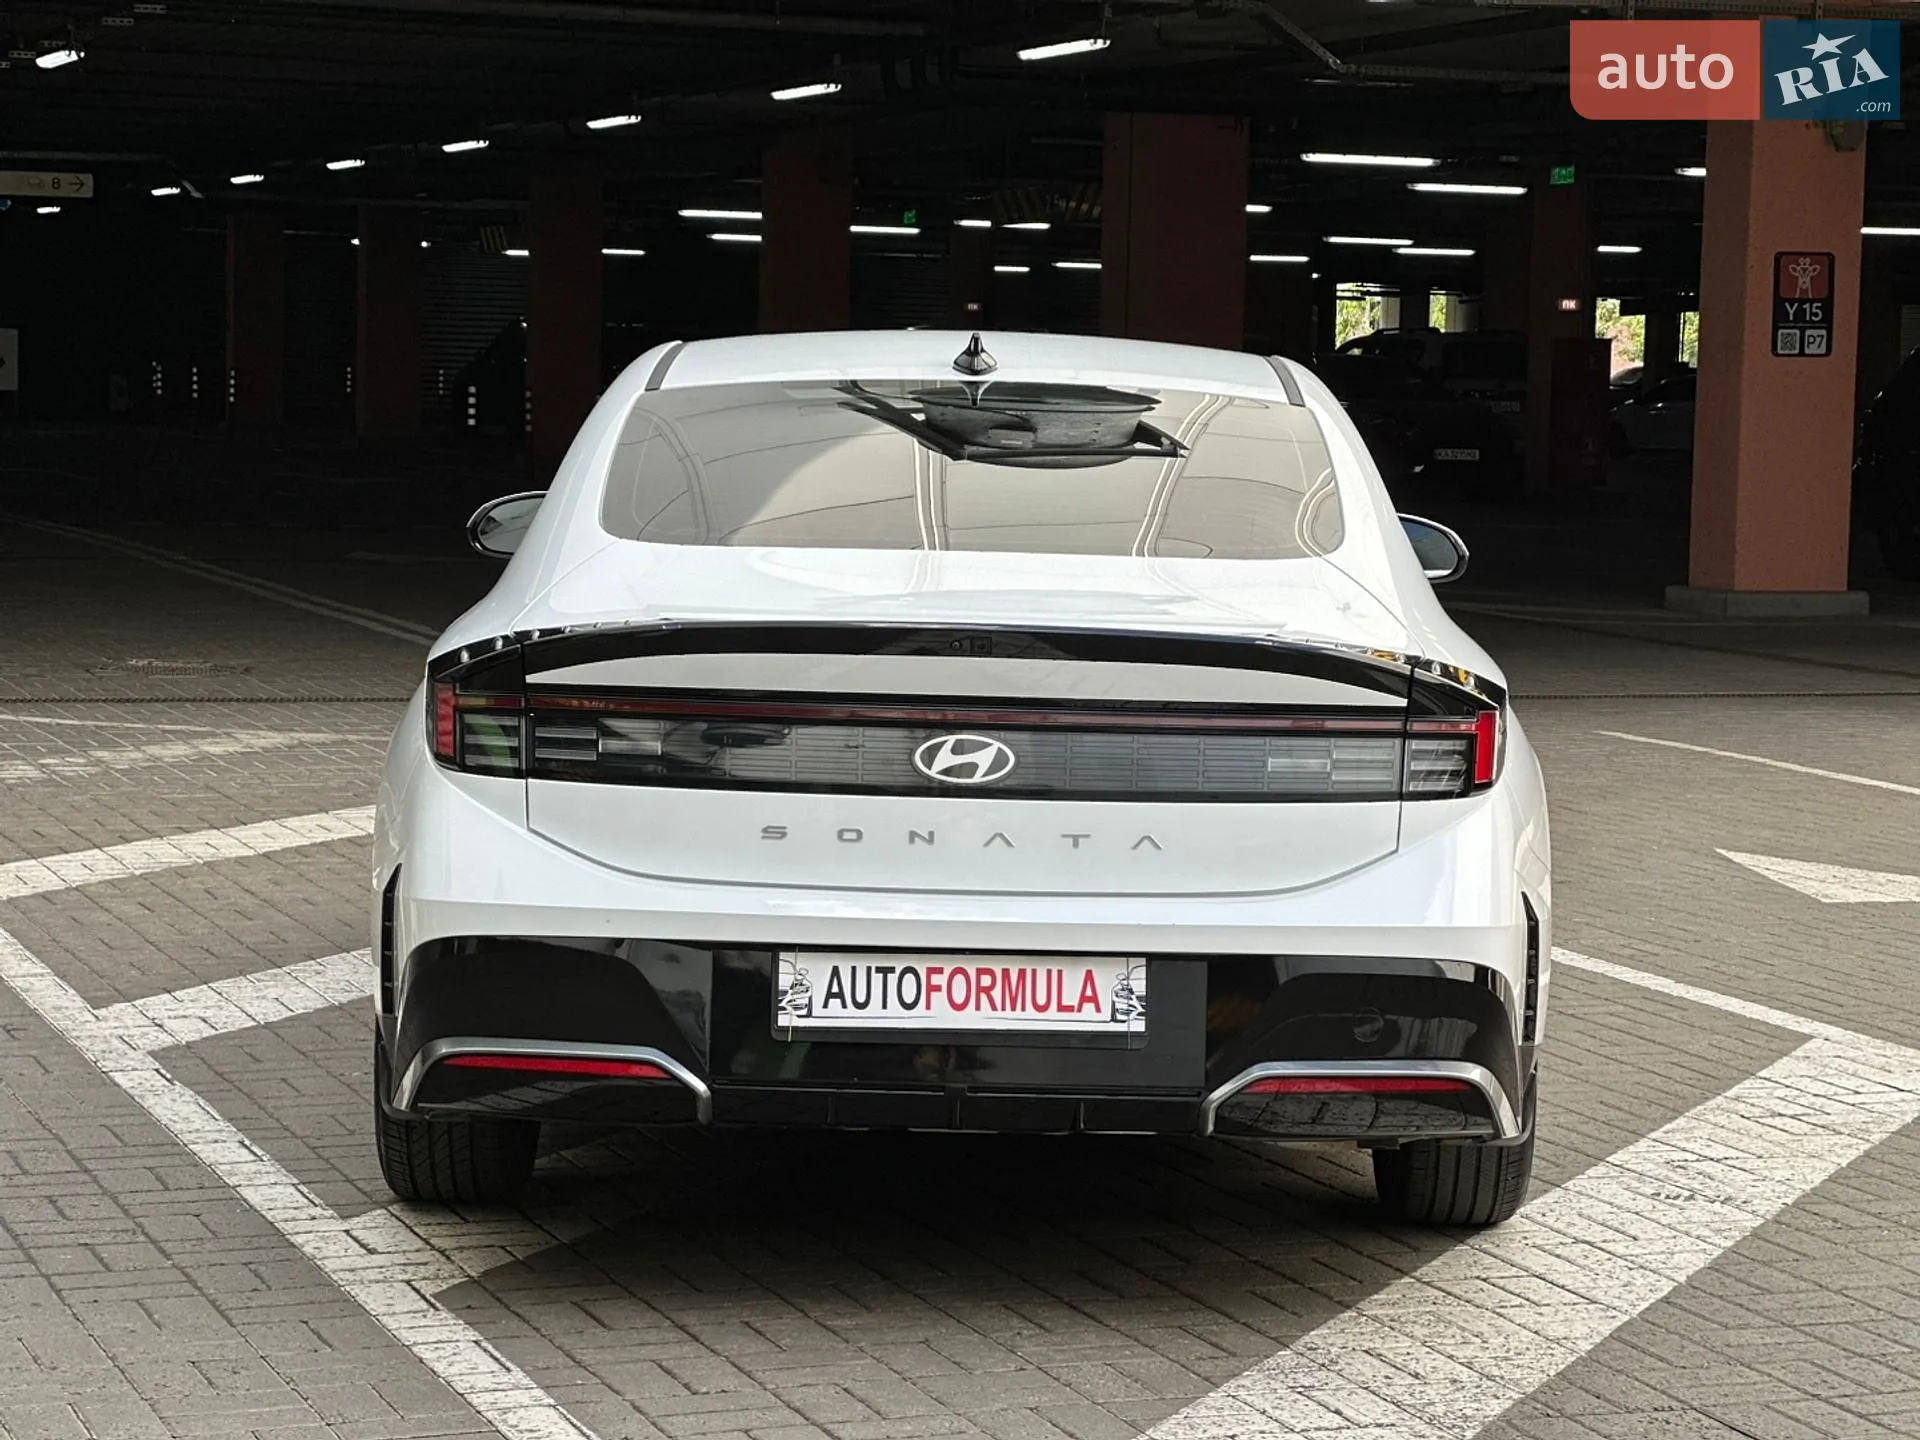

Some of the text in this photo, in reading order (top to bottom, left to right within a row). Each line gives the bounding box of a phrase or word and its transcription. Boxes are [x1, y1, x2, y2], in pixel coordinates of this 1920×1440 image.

[52, 177, 61, 190] 8
[1784, 302, 1823, 322] Y 15
[1806, 334, 1825, 349] P7
[760, 825, 1165, 851] SONATA
[821, 964, 1102, 1014] AUTOFORMULA
